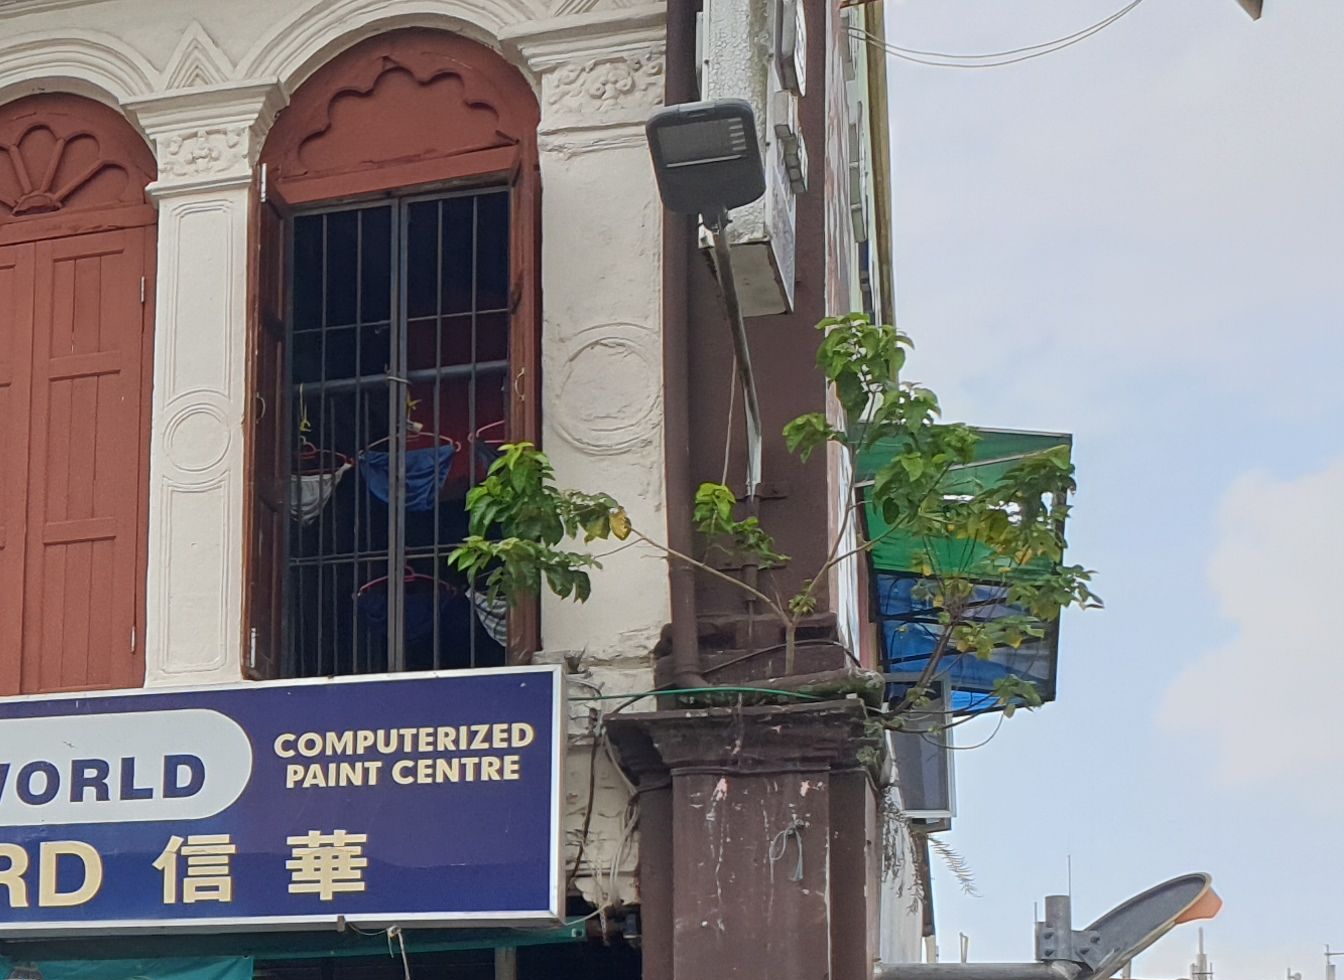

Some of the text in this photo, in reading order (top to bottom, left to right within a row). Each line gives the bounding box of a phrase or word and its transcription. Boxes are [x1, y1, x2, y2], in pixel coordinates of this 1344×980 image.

[273, 722, 535, 759] COMPUTERIZED
[286, 755, 521, 789] PAINT CENTRE
